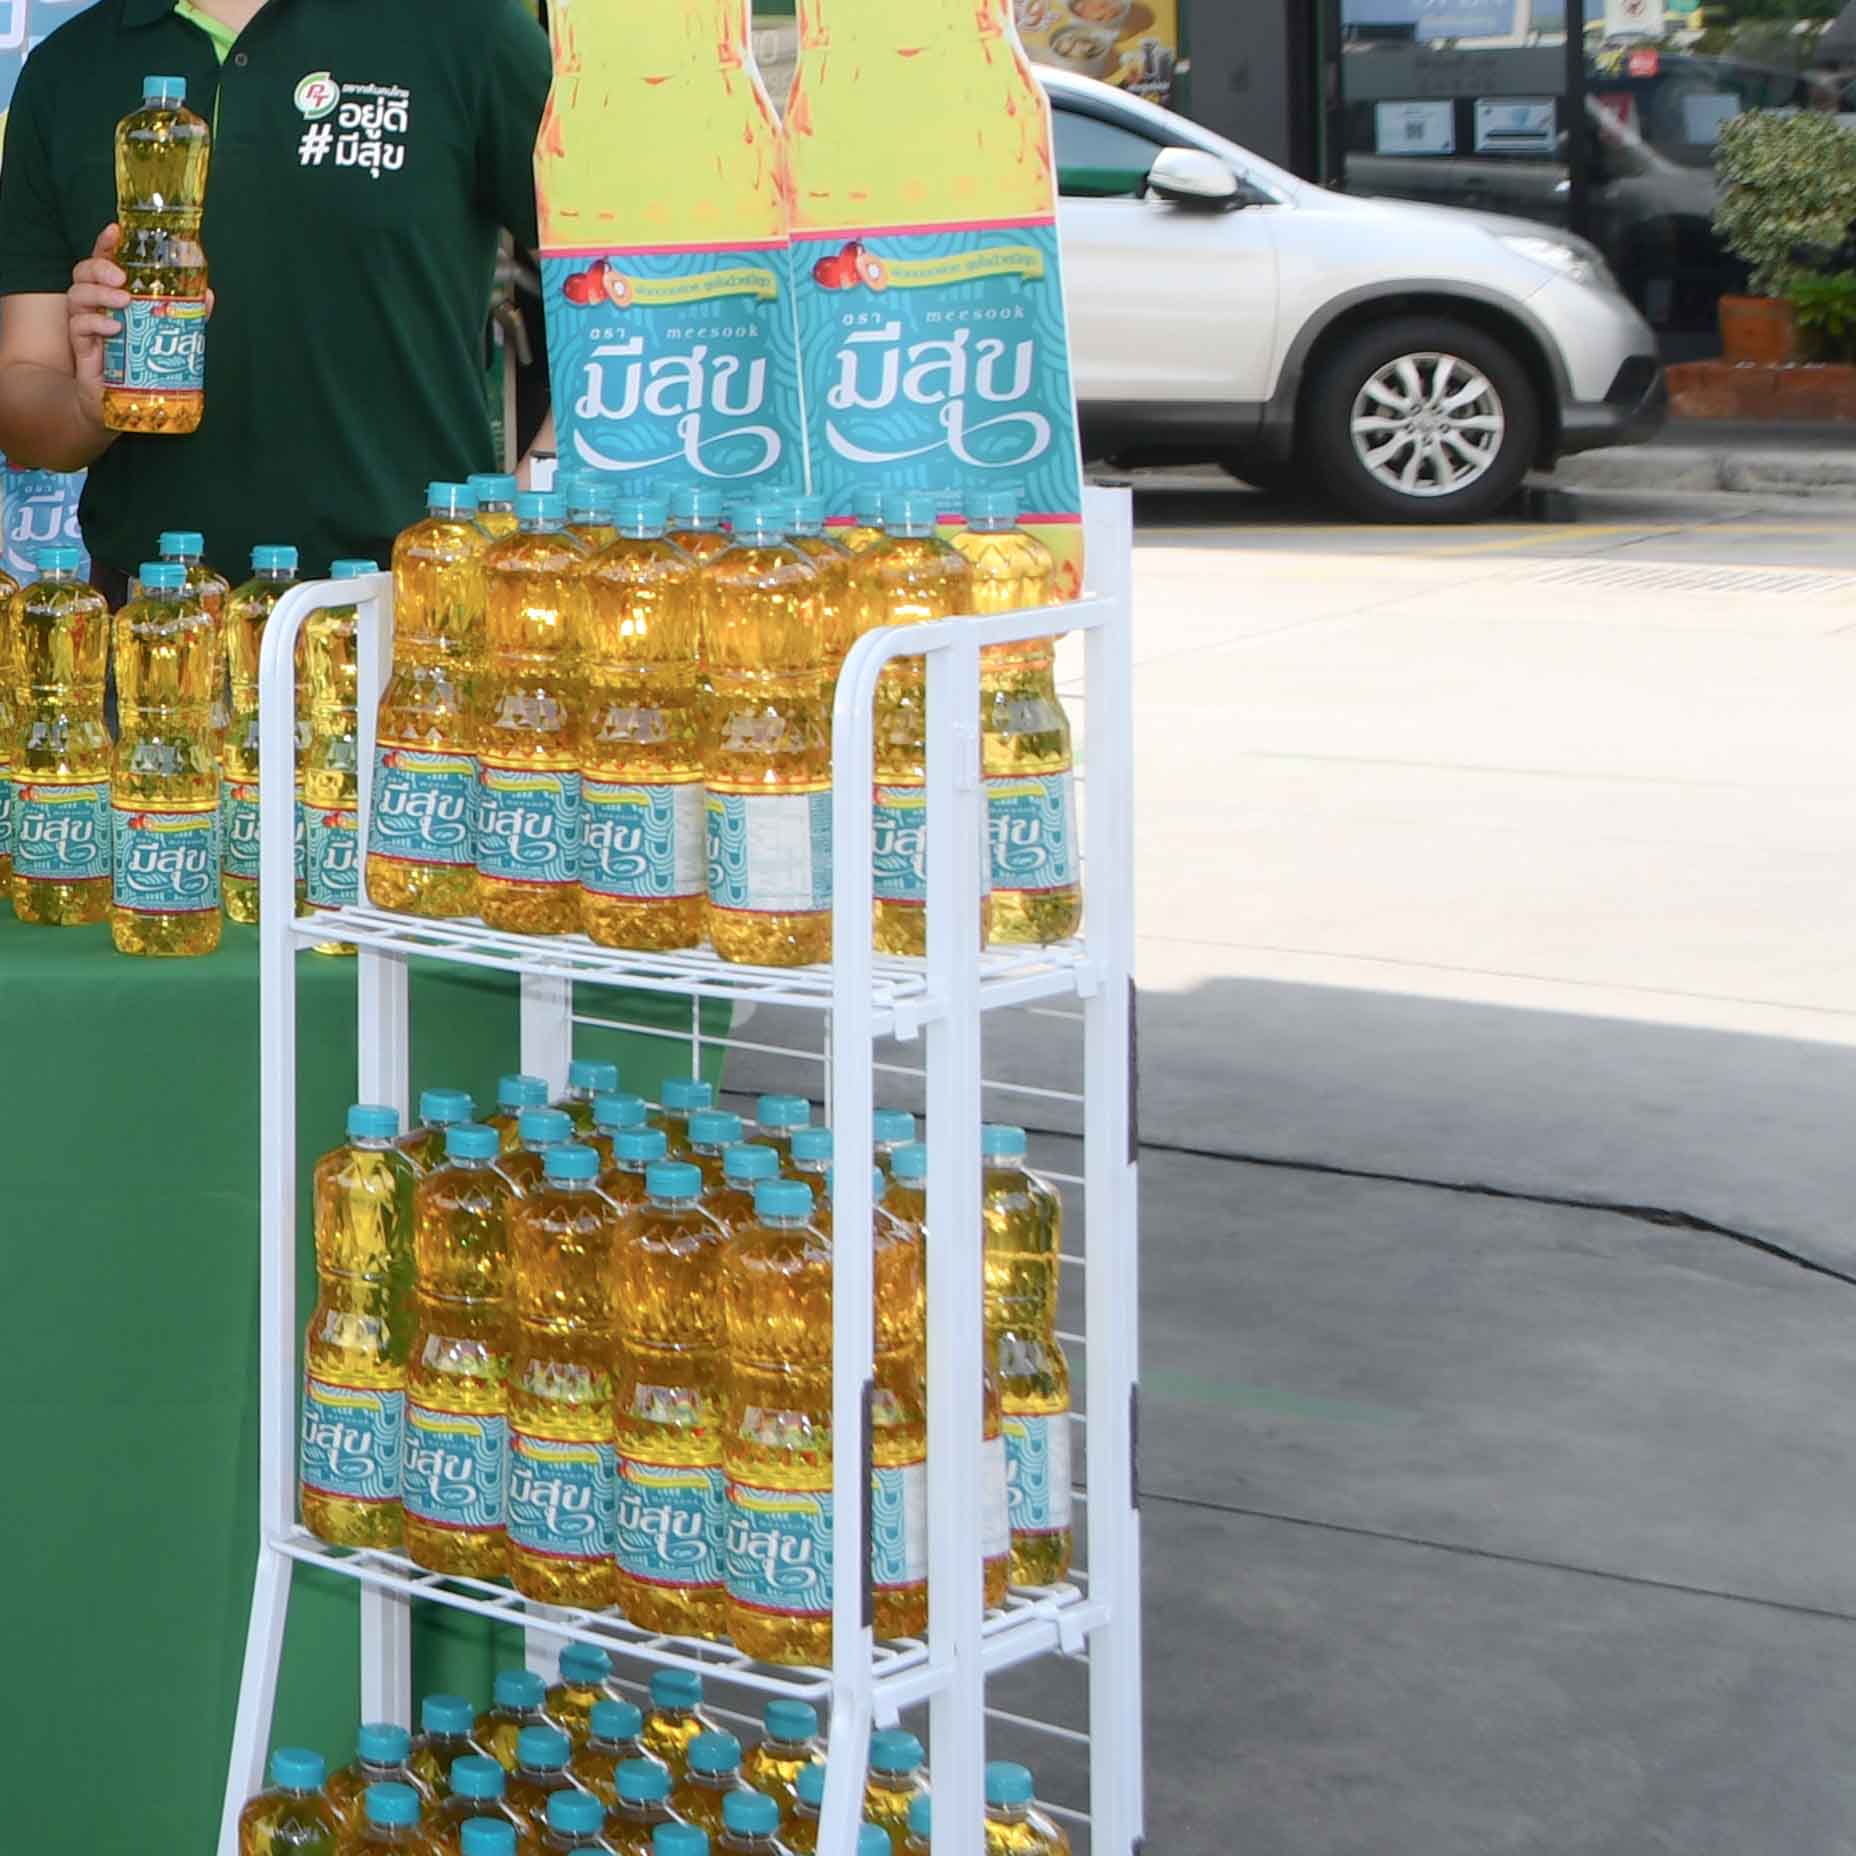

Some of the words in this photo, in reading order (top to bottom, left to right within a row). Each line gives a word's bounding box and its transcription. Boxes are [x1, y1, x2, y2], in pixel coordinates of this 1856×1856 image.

[338, 96, 409, 140] อยู่ดี
[666, 324, 760, 340] meesook
[925, 305, 1026, 323] meesook
[573, 336, 782, 479] มีสุข
[825, 320, 1051, 468] มีสุข
